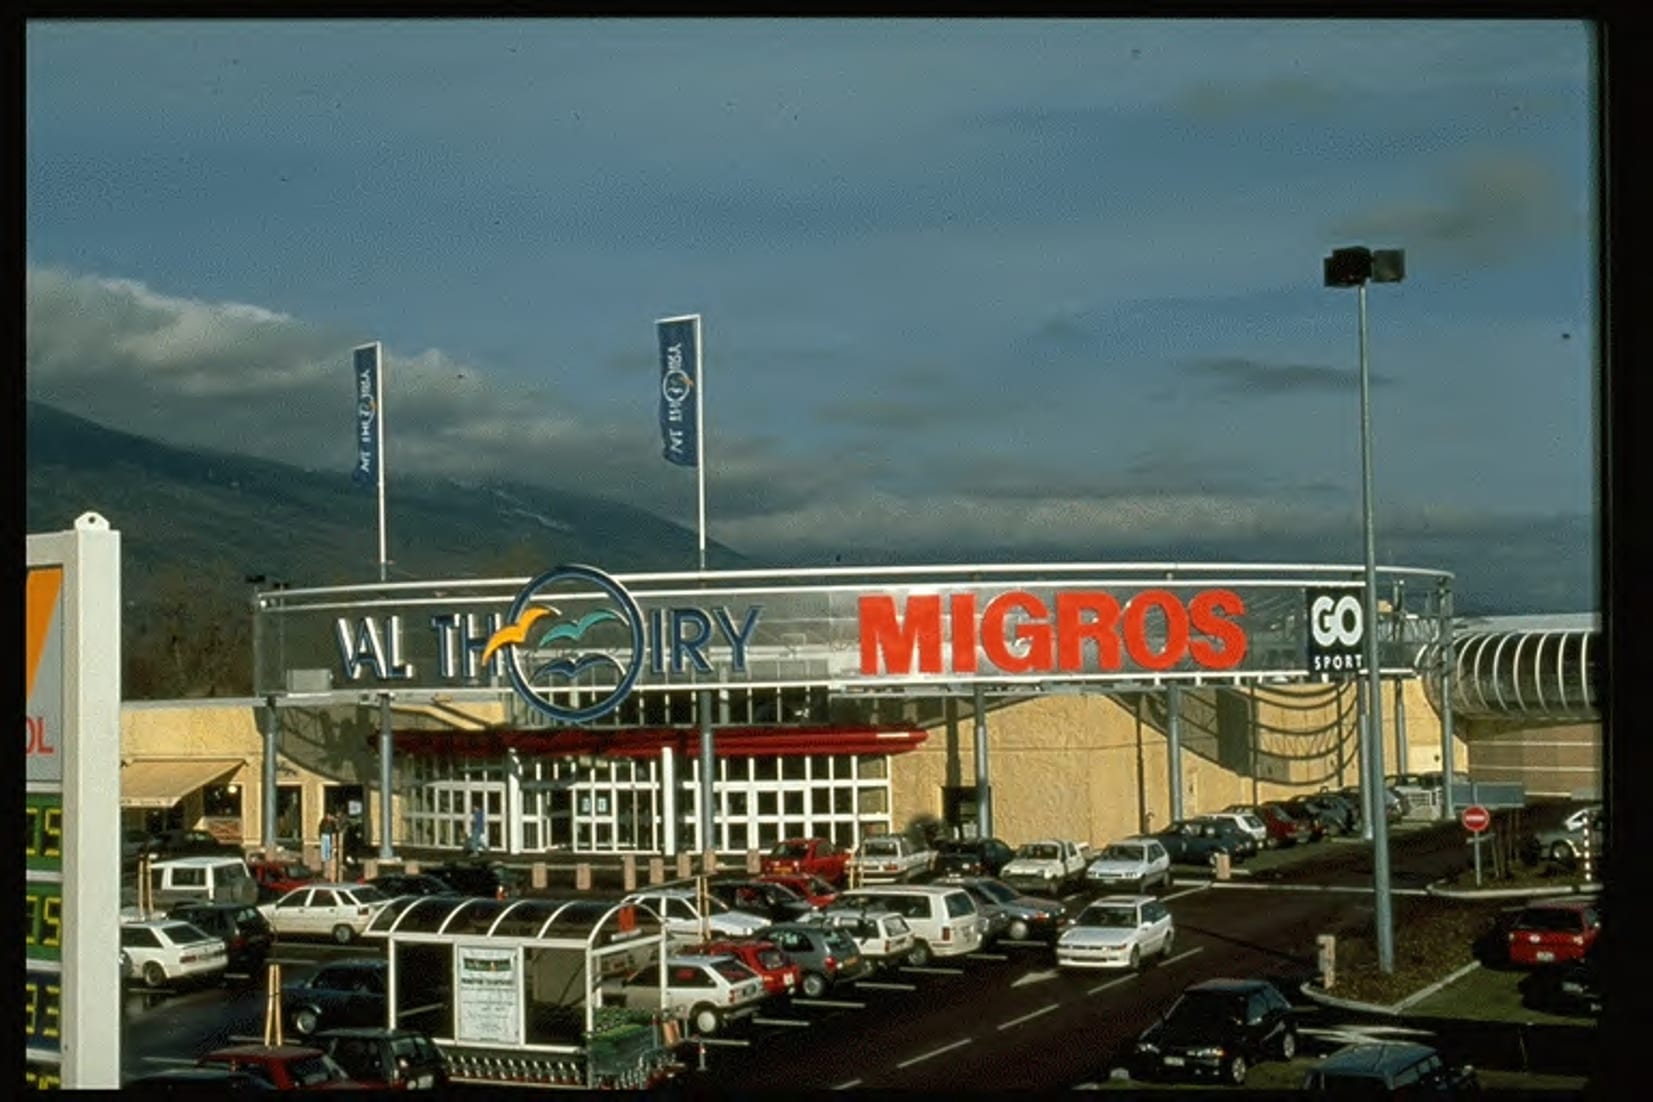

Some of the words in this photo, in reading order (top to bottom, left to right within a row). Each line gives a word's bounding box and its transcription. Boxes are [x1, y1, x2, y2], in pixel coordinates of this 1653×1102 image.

[336, 615, 413, 680] VAL
[858, 588, 1249, 676] MIGROS
[1311, 595, 1364, 647] GO
[1314, 654, 1363, 671] SPORT
